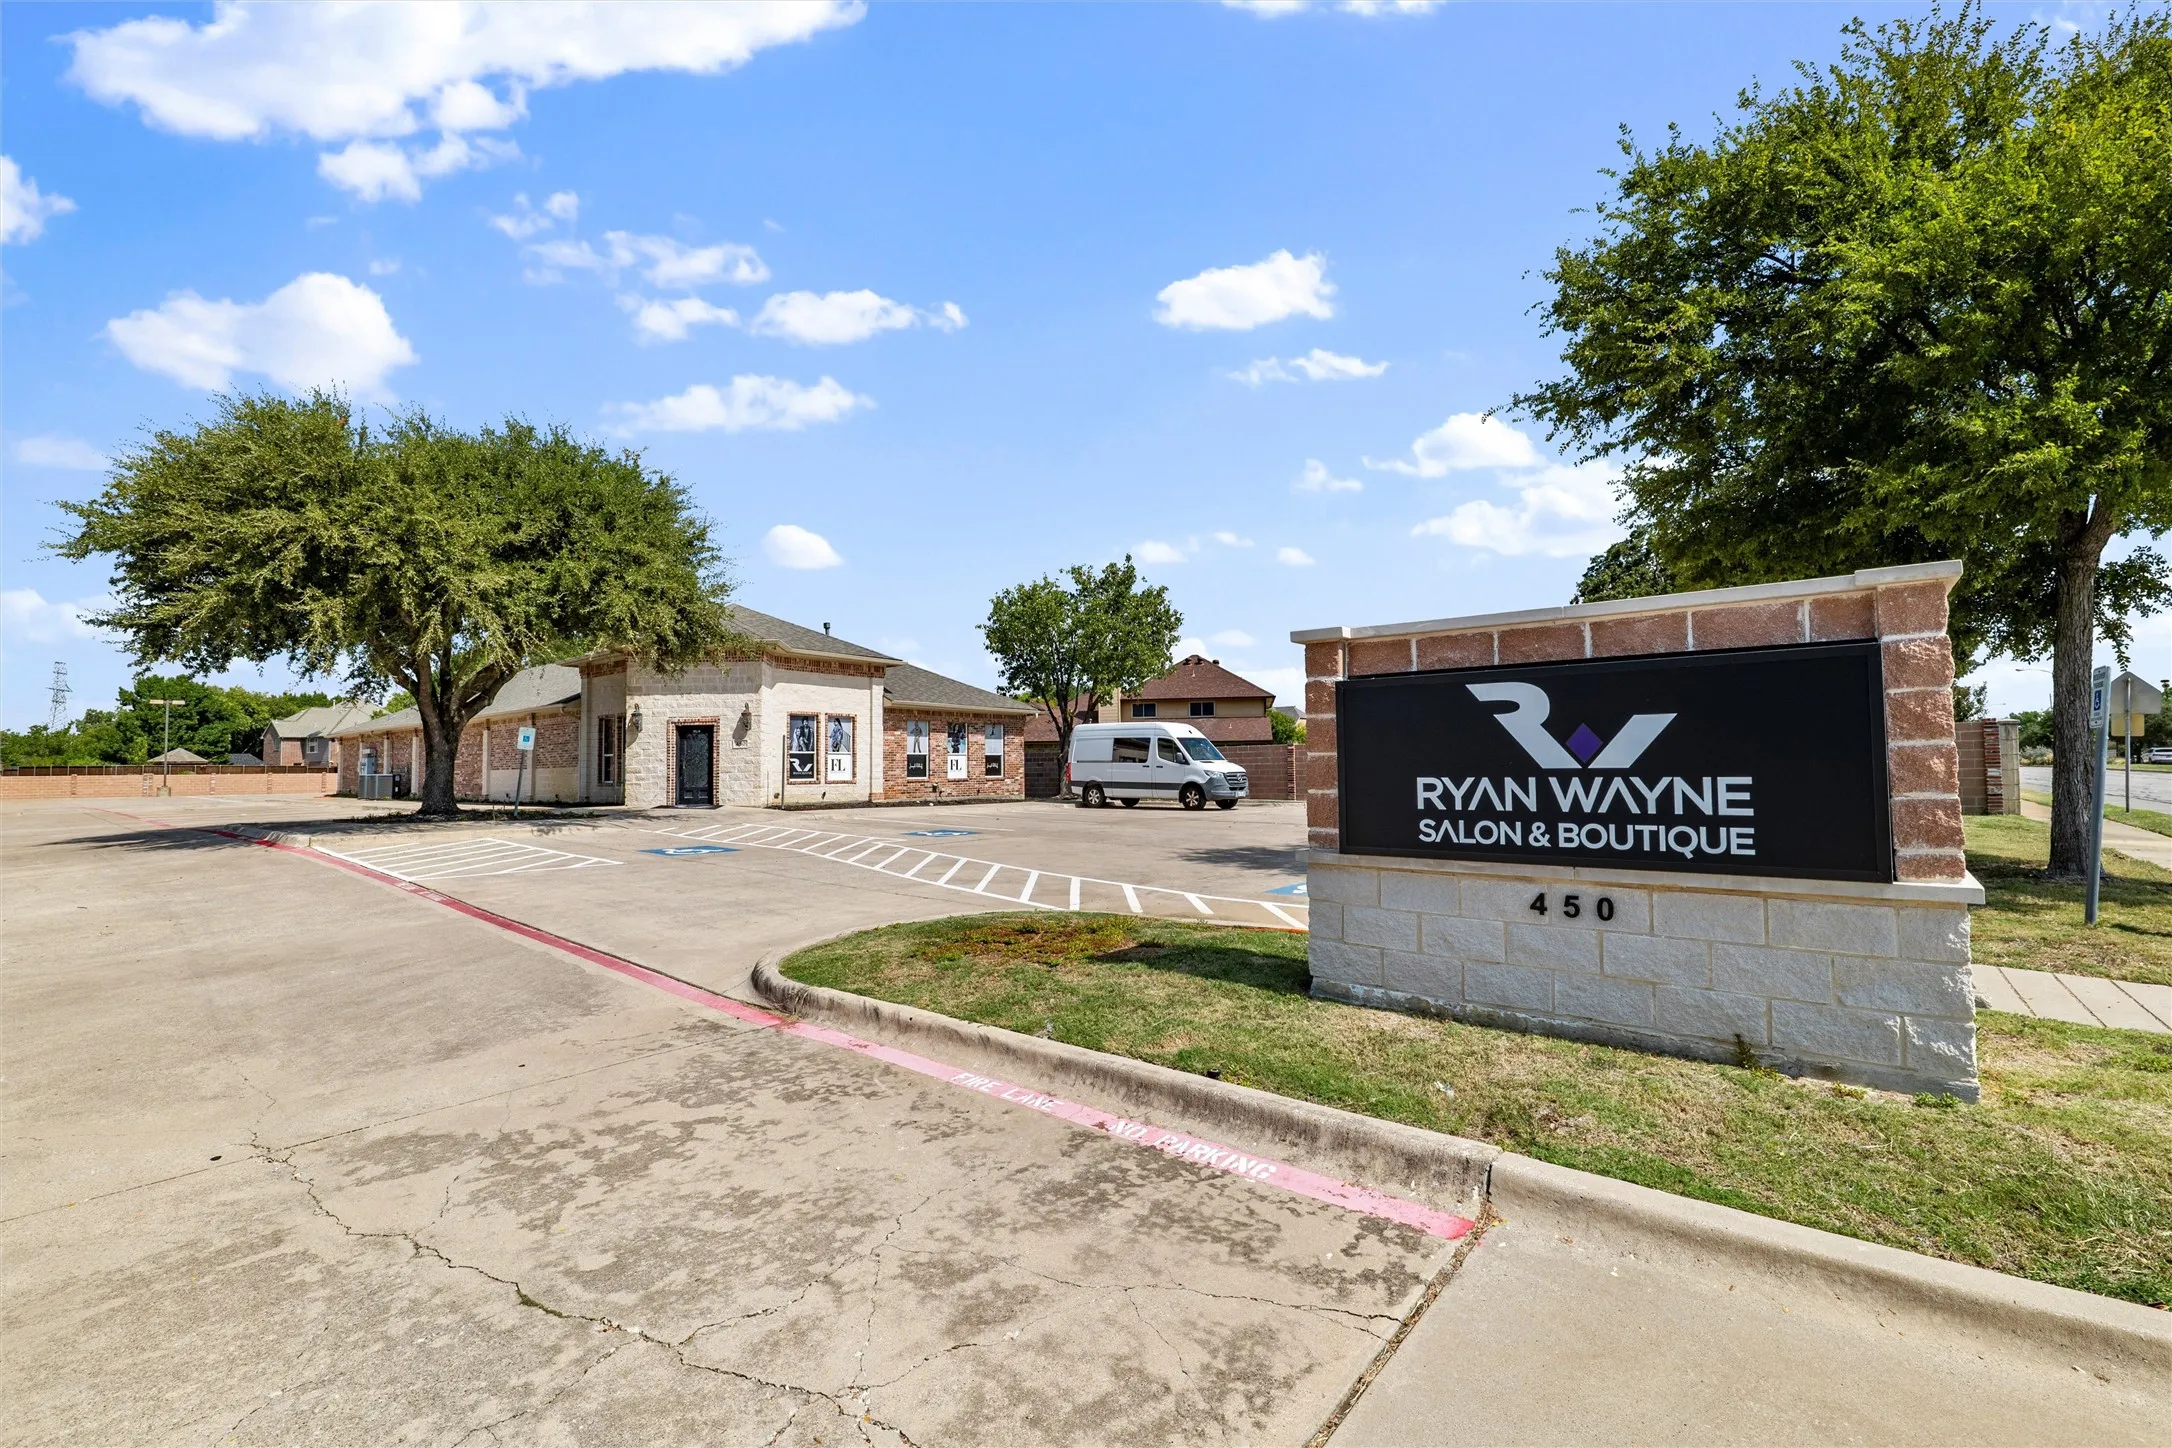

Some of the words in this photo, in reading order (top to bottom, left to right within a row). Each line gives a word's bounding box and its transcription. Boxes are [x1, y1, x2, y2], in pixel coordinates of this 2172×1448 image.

[1416, 776, 1537, 812] RYAN
[1548, 776, 1755, 817] WAYNE
[1418, 818, 1523, 848] SALON
[1528, 821, 1552, 848] &
[1558, 822, 1756, 860] BOUTIQUE
[1529, 892, 1615, 922] 450
[951, 1072, 1003, 1092] FIRE
[1001, 1088, 1065, 1112] LANE
[1109, 1119, 1149, 1138] NO
[1153, 1133, 1278, 1181] PARKING
